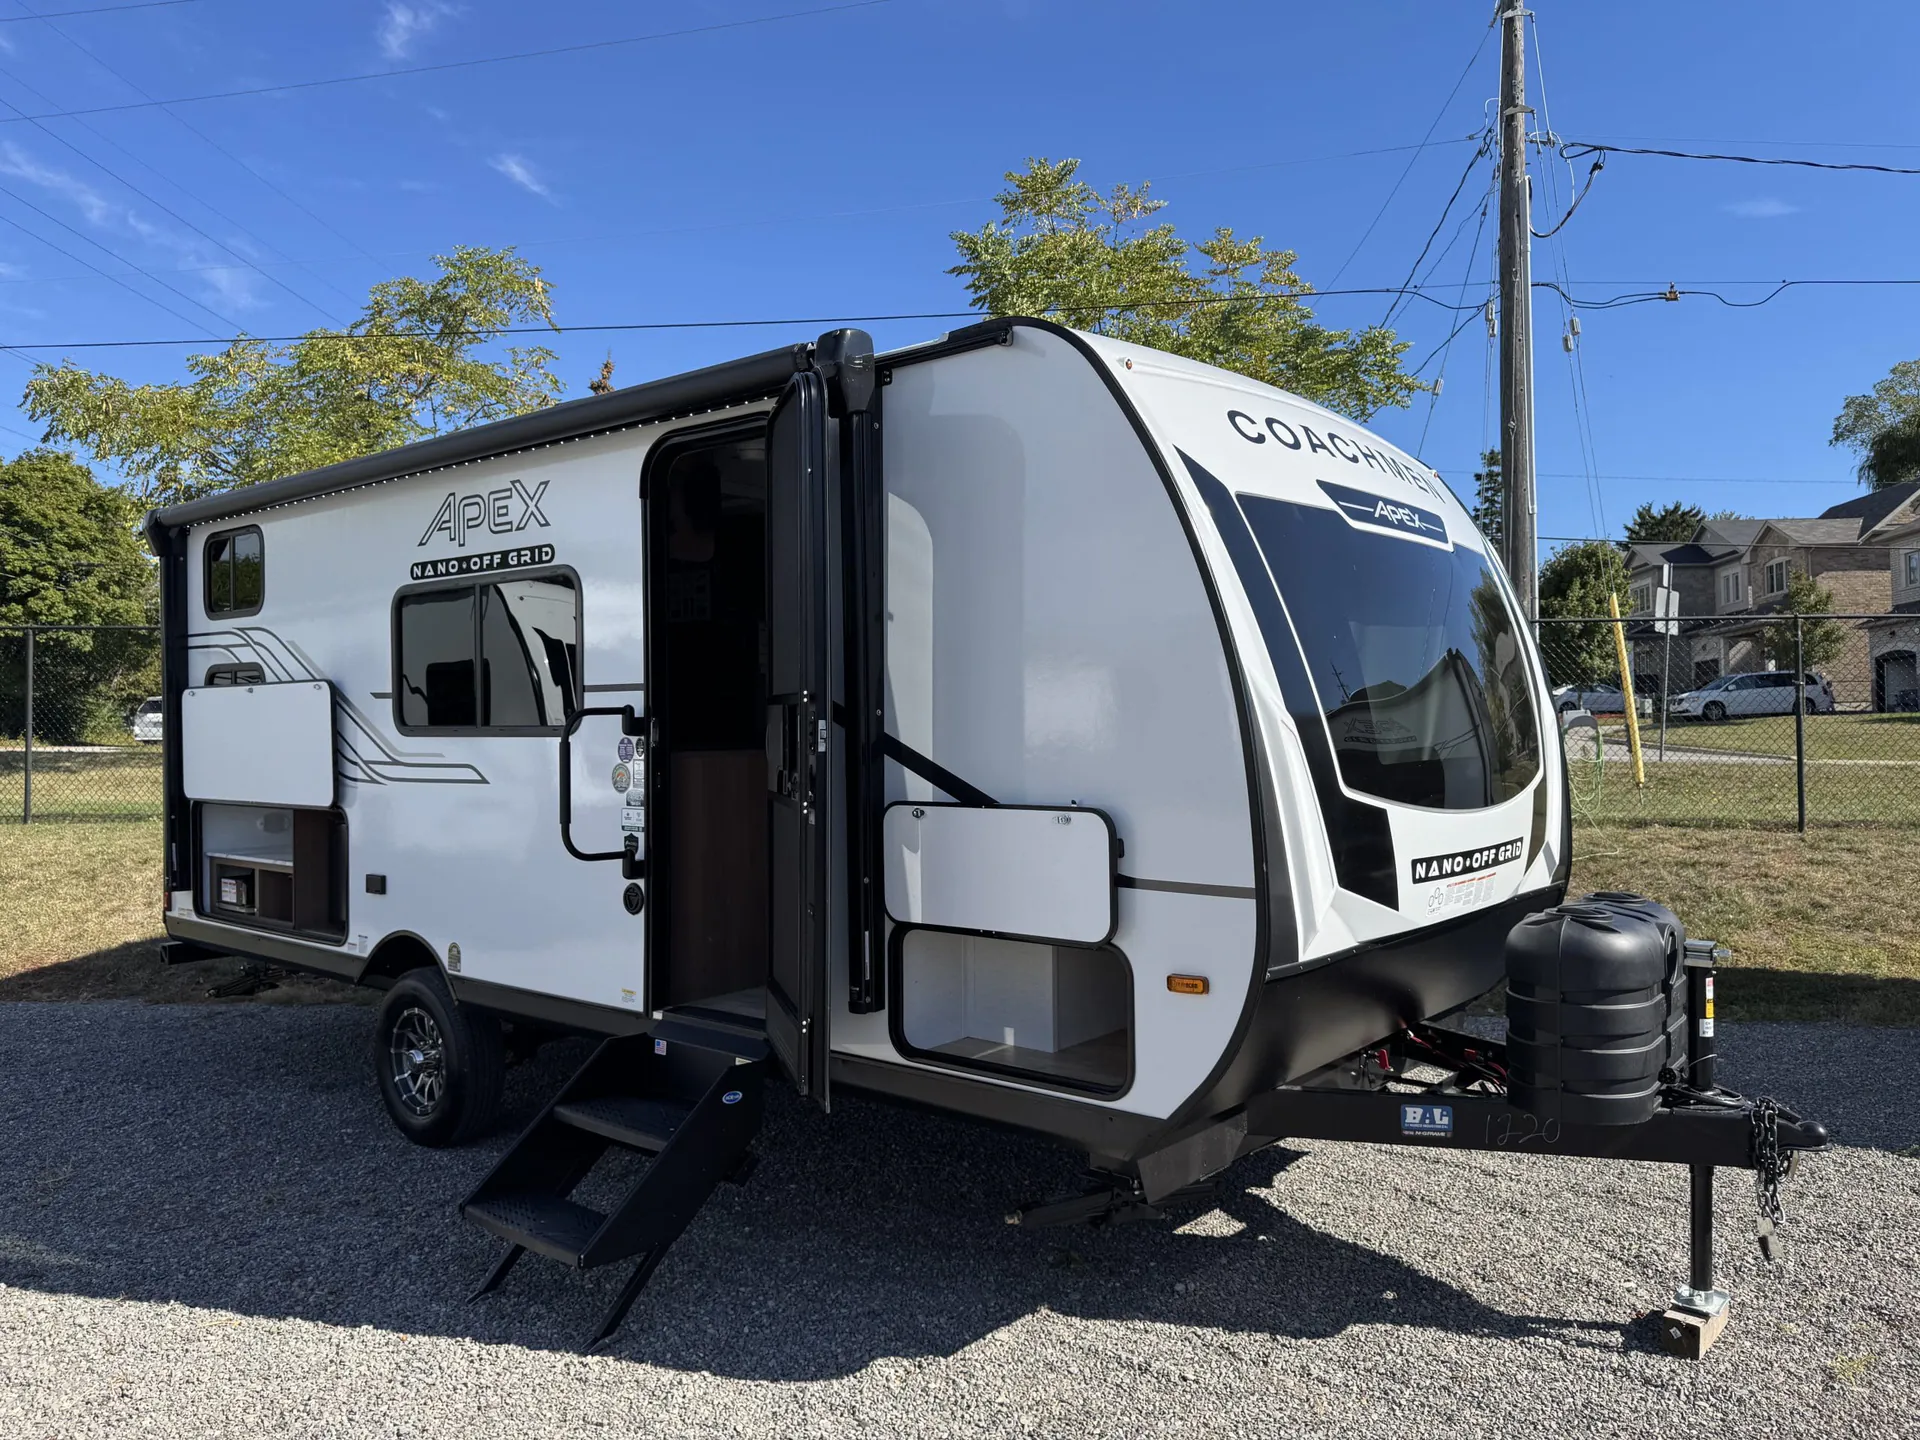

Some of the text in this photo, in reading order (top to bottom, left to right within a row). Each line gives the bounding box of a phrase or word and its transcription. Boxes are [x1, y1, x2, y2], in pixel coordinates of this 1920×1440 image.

[1227, 410, 1446, 504] COACHMEN
[413, 547, 552, 579] NANO OFF GRID
[1415, 841, 1522, 880] NANO OFF GRID
[1405, 1107, 1449, 1124] BAL
[1485, 1113, 1561, 1146] 1220
